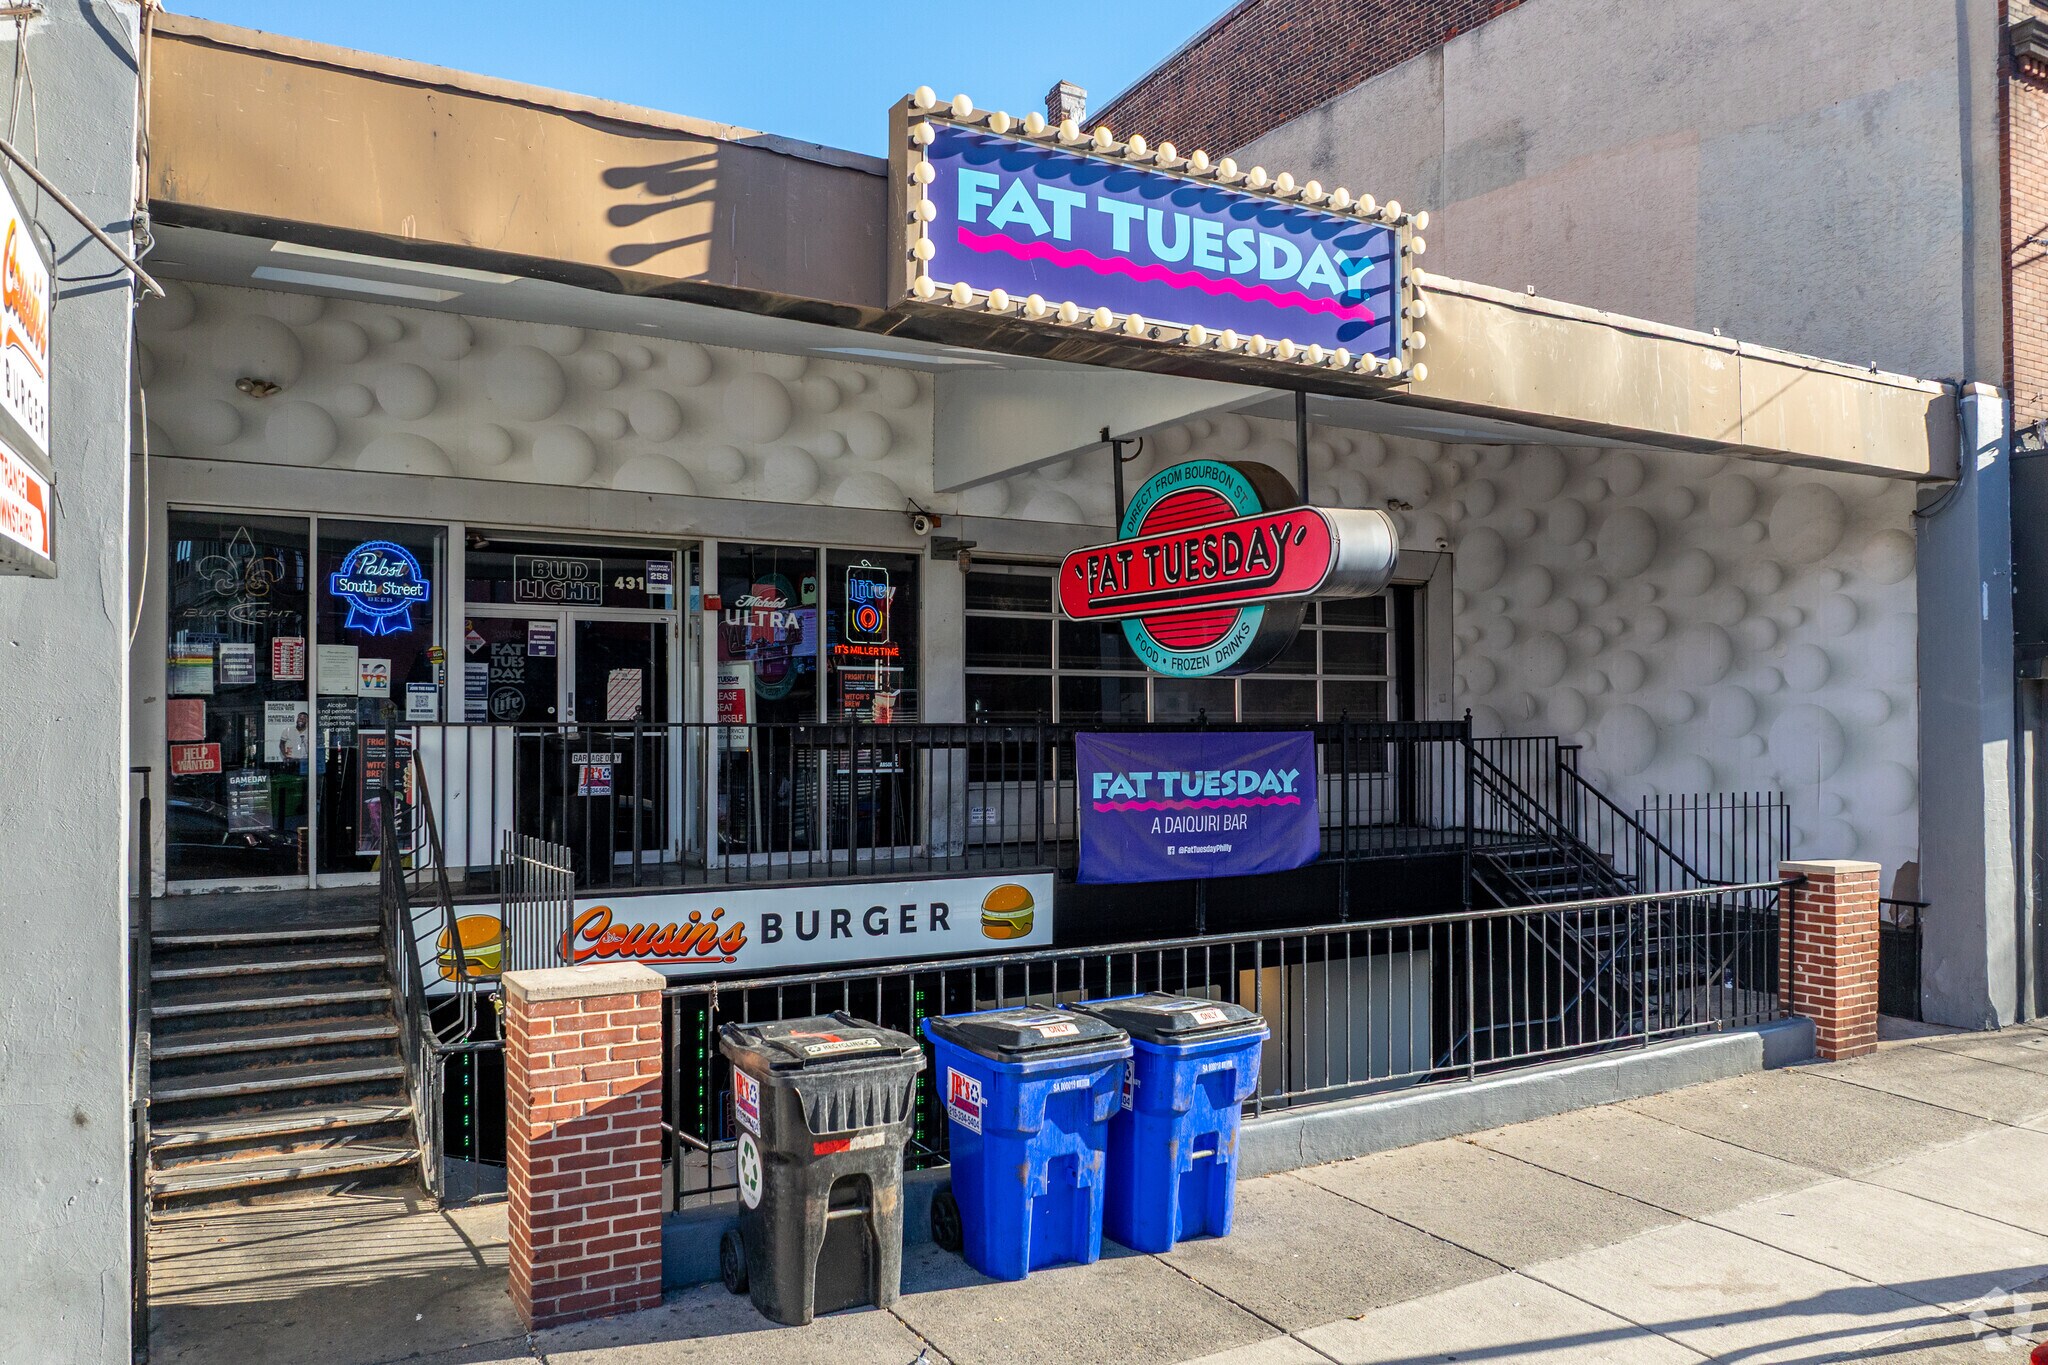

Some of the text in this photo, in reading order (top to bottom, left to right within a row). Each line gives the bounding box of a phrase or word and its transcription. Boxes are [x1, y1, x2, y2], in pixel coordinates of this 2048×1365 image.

[958, 167, 1375, 299] FAT TUESDAY
[3, 218, 47, 360] Cousin's
[6, 357, 45, 441] BURGER
[0, 453, 25, 500] TRANCE
[1127, 466, 1250, 534] DIRECT FROM BOURBON ST.
[0, 495, 32, 541] WNSTAIRS
[357, 551, 408, 577] Pabst
[532, 559, 589, 579] BUD
[615, 576, 644, 590] 431
[650, 572, 669, 580] 258
[339, 579, 424, 596] South Street
[520, 579, 601, 600] LIGHT
[848, 578, 888, 603] Lite
[367, 596, 393, 604] BEER
[735, 594, 788, 609] Michelob
[183, 608, 226, 617] BUD
[239, 609, 294, 618] LIGHT
[725, 608, 800, 629] ULTRA
[491, 643, 525, 655] FAT
[835, 644, 899, 657] IT'S MILLER TIME
[1135, 622, 1251, 671] FOOD FROZEN DRINKS
[490, 655, 525, 667] TUES
[717, 691, 737, 700] EASE
[844, 693, 870, 701] WITCH'S
[493, 696, 521, 714] Lite
[717, 703, 732, 712] SEAT
[717, 714, 743, 723] URSELF
[366, 738, 386, 746] FRIG
[183, 747, 208, 761] HELP
[573, 754, 604, 763] GARAGE
[177, 759, 215, 771] WANTED
[366, 761, 400, 769] WITCS
[230, 775, 267, 784] GAMEDAY
[1092, 771, 1153, 799] FAT
[1151, 813, 1248, 834] A DAIQUIRI BAR
[1178, 843, 1232, 855] @FatTuesdayPhilly
[562, 901, 952, 963] Cousin's BURGER
[1200, 1011, 1218, 1020] ONLY
[1048, 1024, 1069, 1034] ONLY
[822, 1039, 865, 1051] RECYCLING
[736, 1071, 750, 1104] JR's
[949, 1072, 970, 1103] JR's
